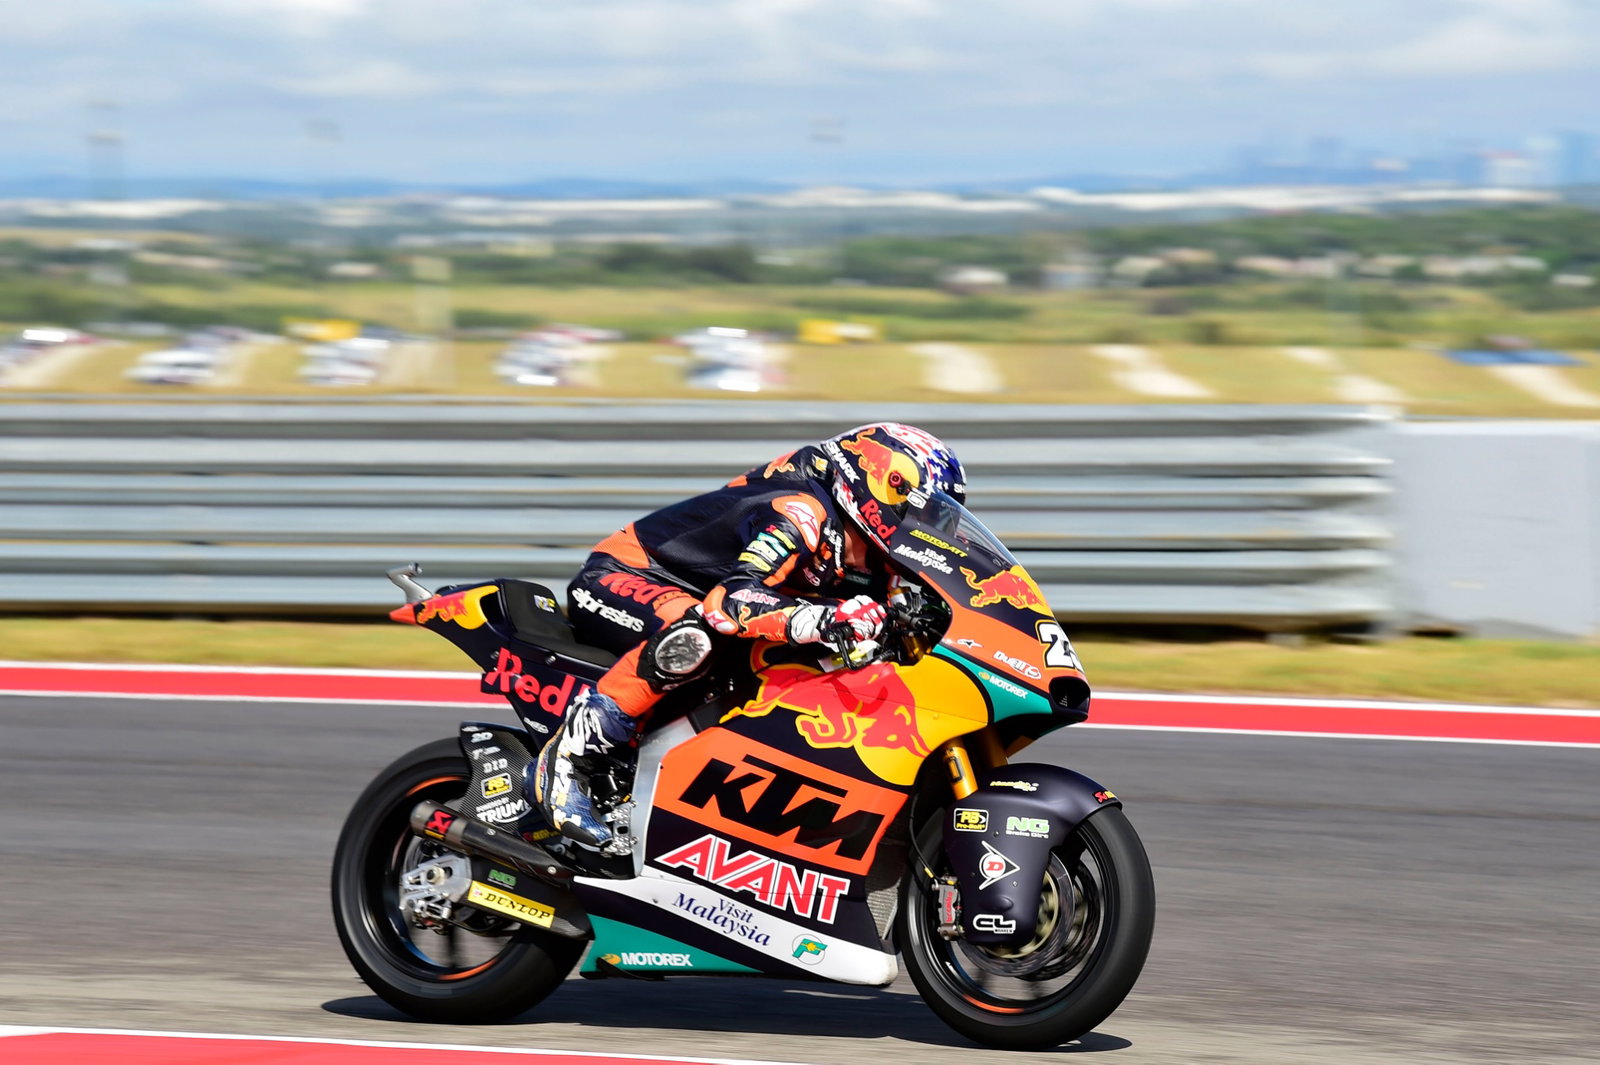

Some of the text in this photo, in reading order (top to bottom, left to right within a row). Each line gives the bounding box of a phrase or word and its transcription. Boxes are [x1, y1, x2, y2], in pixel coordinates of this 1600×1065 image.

[826, 442, 861, 484] SHARK
[859, 499, 898, 540] Red
[909, 529, 968, 558] MOTOBATT
[894, 544, 954, 575] Malaysia
[572, 587, 645, 632] alpinestars
[1038, 622, 1086, 675] 2
[484, 647, 576, 718] Red
[989, 675, 1029, 699] MOTOREX
[477, 798, 529, 823] TRIUM
[678, 754, 885, 862] KTM
[960, 810, 980, 824] PB
[1006, 816, 1050, 833] NG
[654, 833, 851, 925] AVANT
[485, 893, 550, 919] DUNLOP
[671, 892, 772, 947] Malaysia
[719, 898, 754, 924] Visit
[621, 952, 693, 968] MOTOREX
